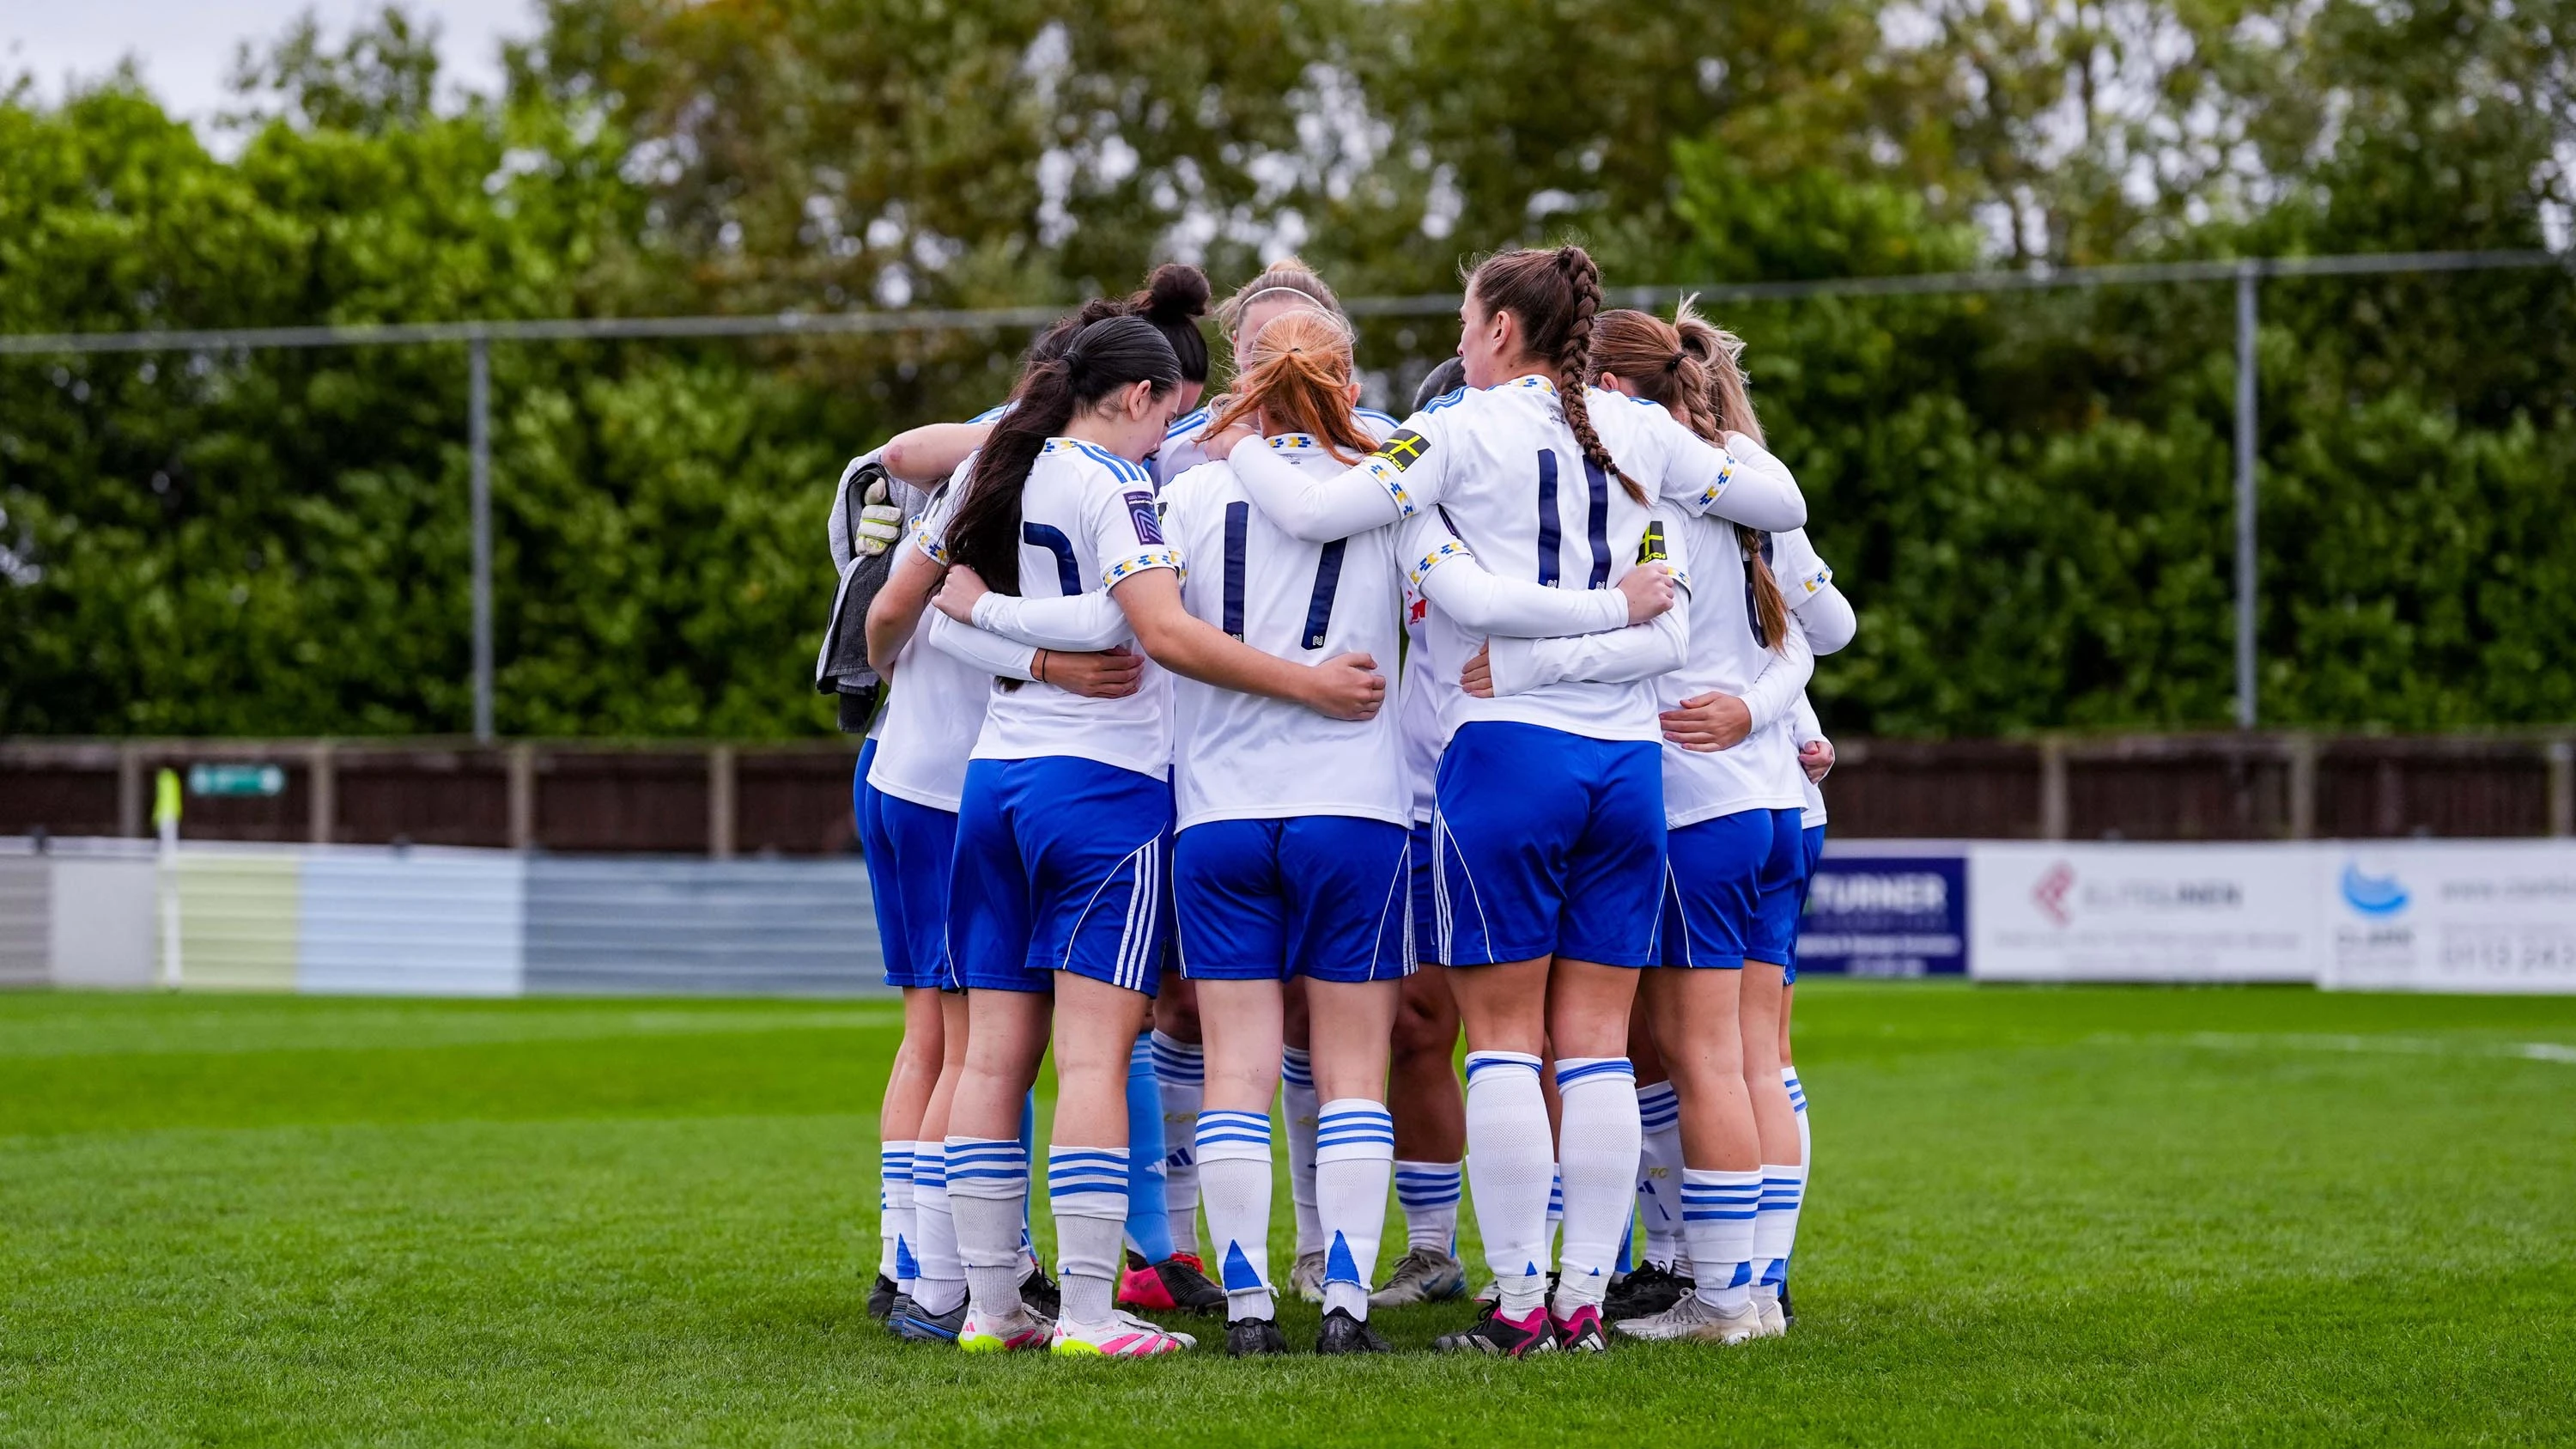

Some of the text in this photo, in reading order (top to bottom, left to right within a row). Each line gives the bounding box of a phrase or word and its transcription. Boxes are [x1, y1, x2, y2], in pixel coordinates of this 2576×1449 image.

[1223, 501, 1348, 650] 17
[1537, 448, 1612, 590] 11
[1813, 873, 1947, 913] TURNER
